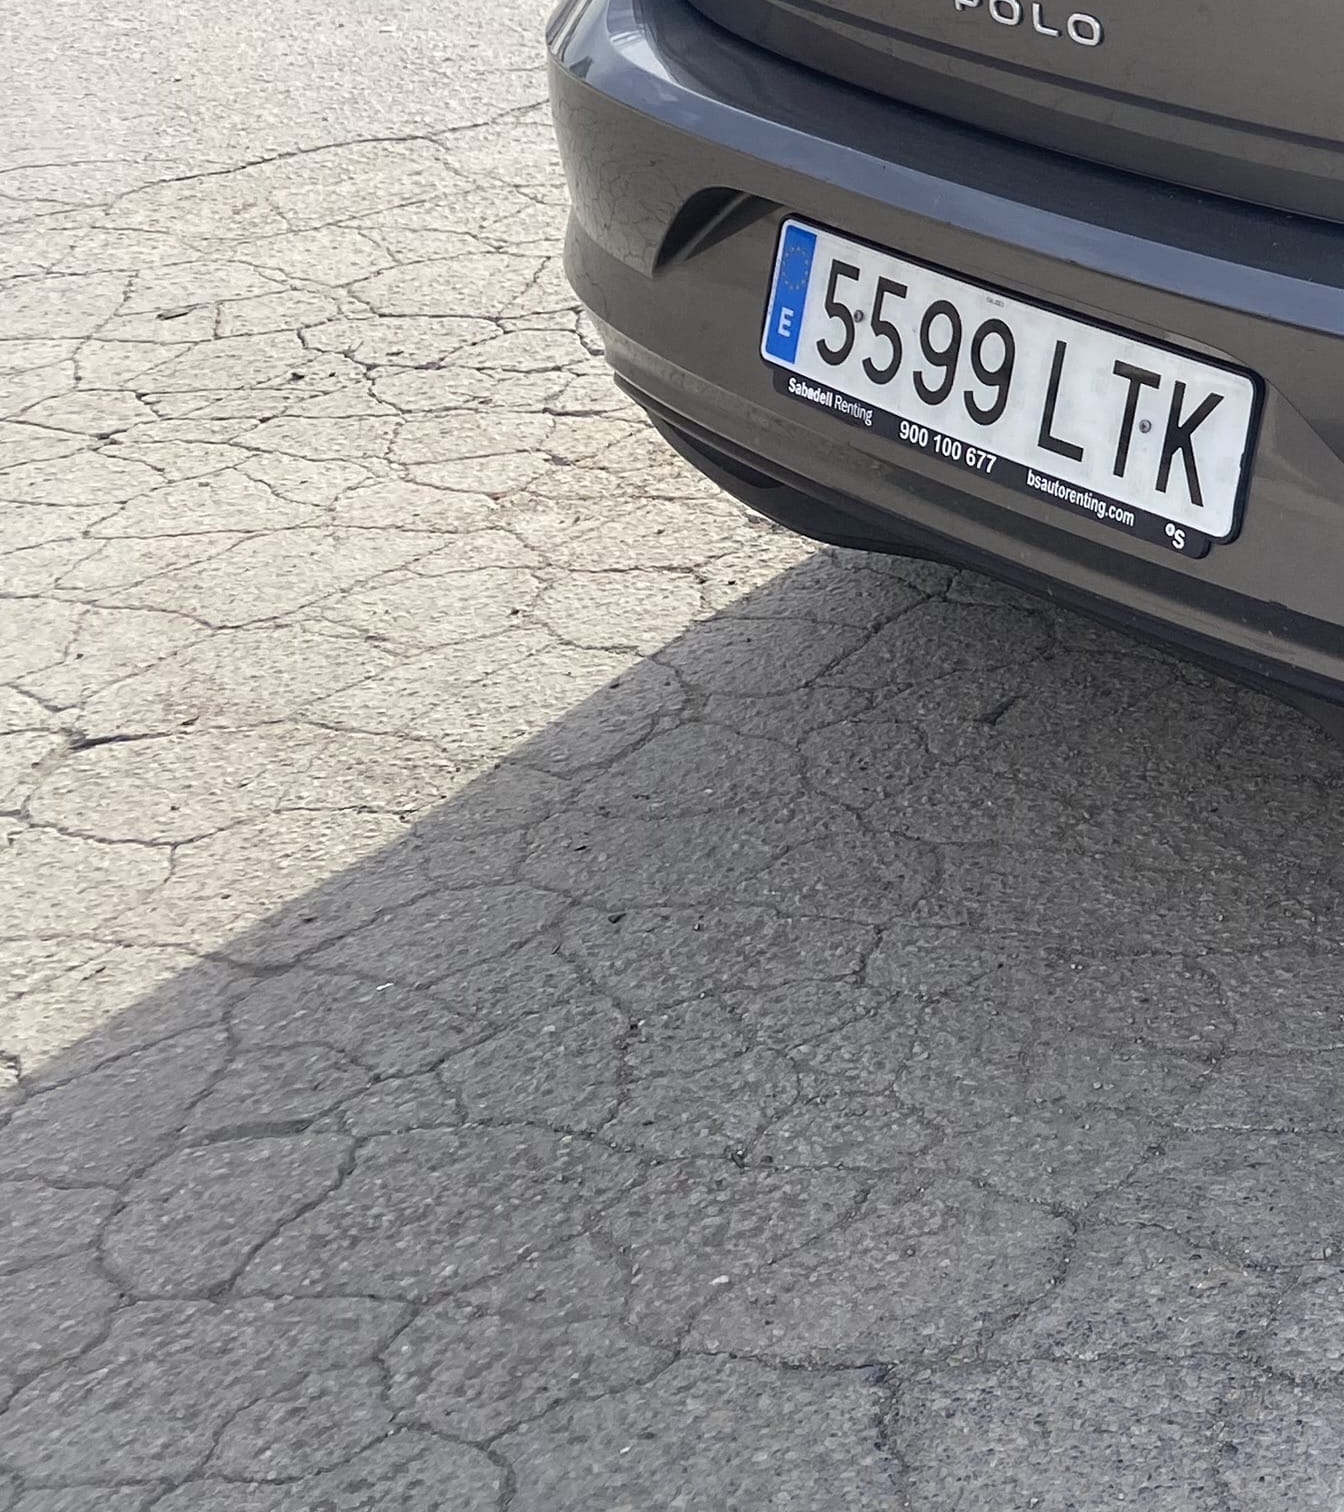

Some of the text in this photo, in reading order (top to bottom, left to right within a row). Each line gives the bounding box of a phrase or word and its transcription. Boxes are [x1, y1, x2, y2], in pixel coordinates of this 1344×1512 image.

[778, 307, 795, 338] E
[788, 377, 873, 426] Sabadell Renting
[816, 259, 1224, 508] 5599 LTK
[899, 421, 997, 474] 900 100 677
[1026, 469, 1135, 526] bsautorenting.com
